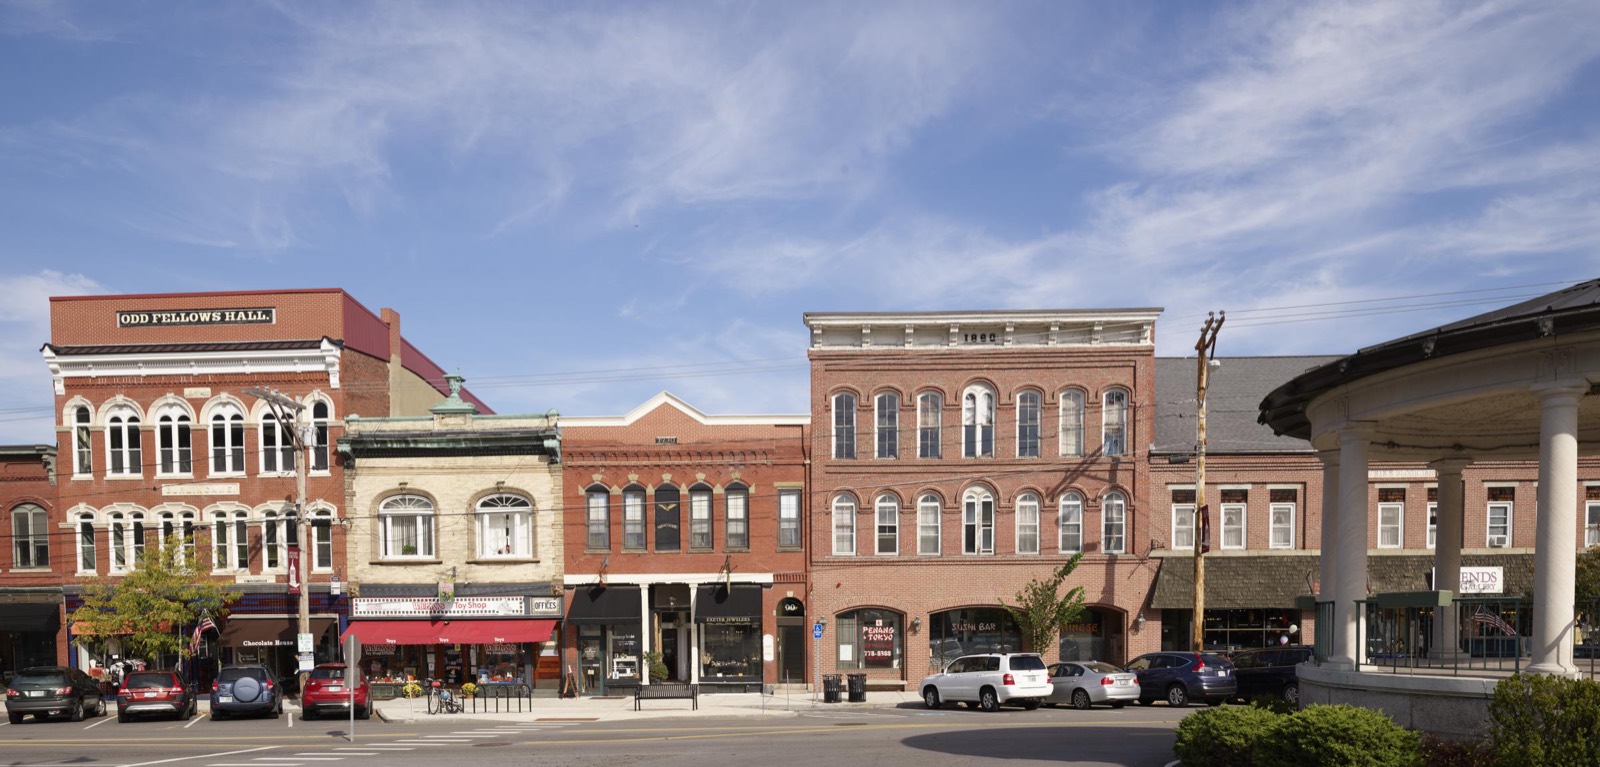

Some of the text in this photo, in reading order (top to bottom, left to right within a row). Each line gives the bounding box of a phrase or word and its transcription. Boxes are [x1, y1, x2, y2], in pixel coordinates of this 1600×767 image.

[121, 311, 270, 324] ODD FELLOWS HALL.
[455, 602, 487, 610] Toy Shop
[535, 602, 557, 610] OFFICES
[862, 626, 895, 634] PENANG
[951, 622, 996, 632] SUSHI BAR
[1060, 623, 1098, 632] HINESE
